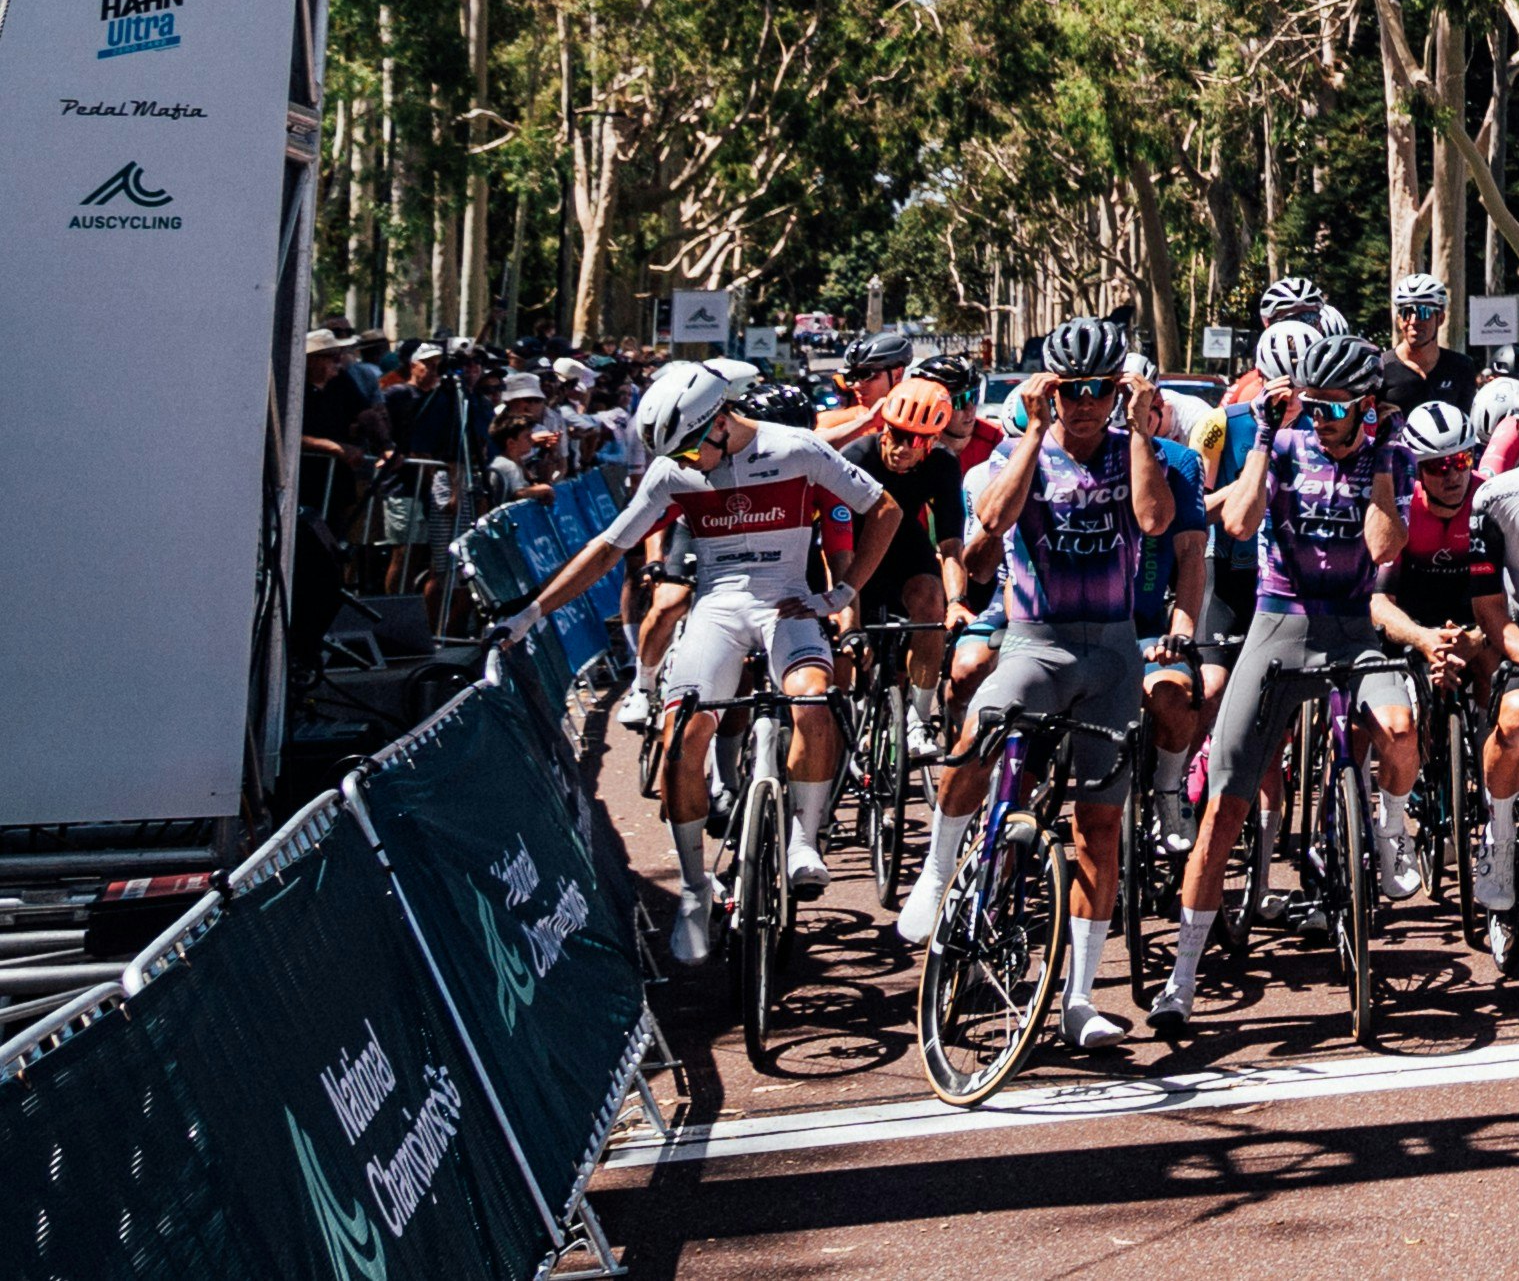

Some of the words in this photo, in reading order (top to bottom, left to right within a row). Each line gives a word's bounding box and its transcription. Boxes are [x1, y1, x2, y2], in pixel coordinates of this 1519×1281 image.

[107, 11, 175, 47] Ultra
[60, 99, 129, 116] Pedal
[130, 100, 208, 120] Mafia
[69, 215, 181, 230] AUSCYCLING
[1033, 483, 1129, 509] Jayco
[1281, 472, 1374, 500] Jayco
[702, 506, 785, 529] Coupland's
[1036, 532, 1126, 555] ALULA
[320, 1018, 396, 1146] National
